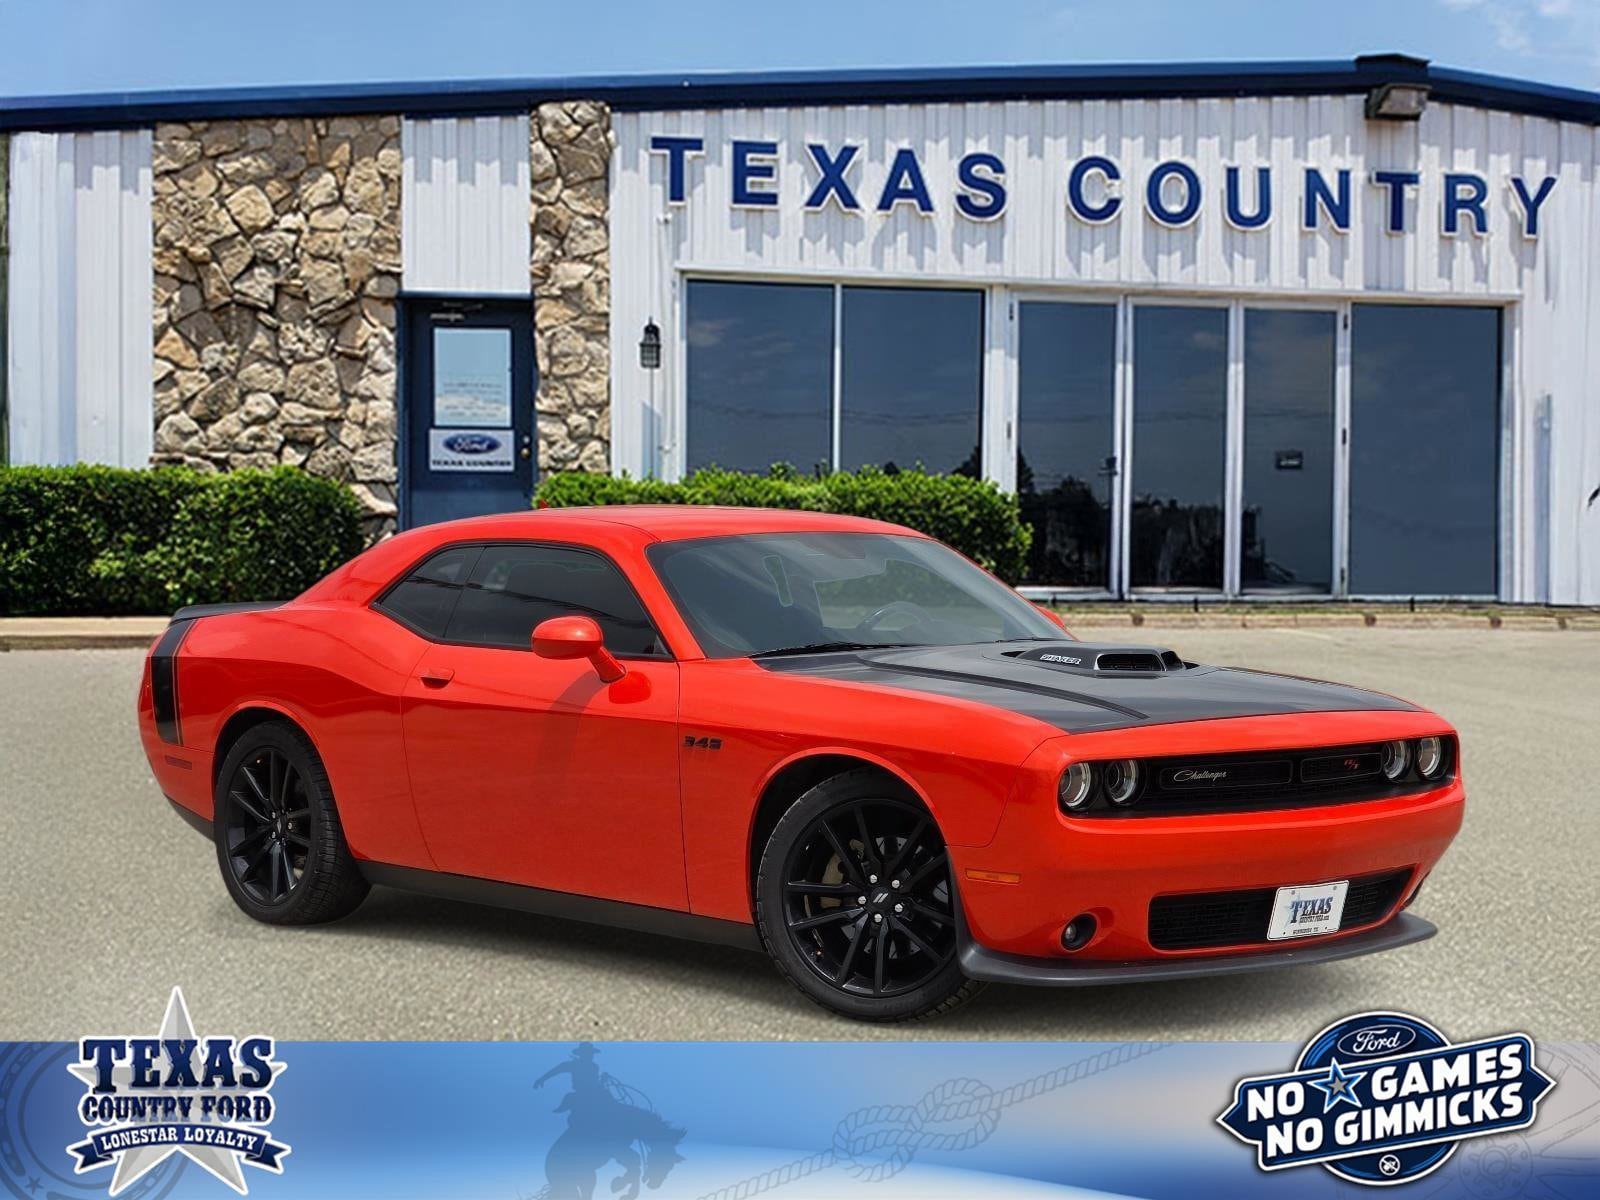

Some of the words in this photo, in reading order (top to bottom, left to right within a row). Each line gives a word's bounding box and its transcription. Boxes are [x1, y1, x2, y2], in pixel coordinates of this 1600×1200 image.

[650, 136, 1008, 222] TEXAS
[1067, 154, 1557, 238] COUNTRY
[1173, 769, 1227, 782] Challenger
[1290, 896, 1333, 924] TEXAS
